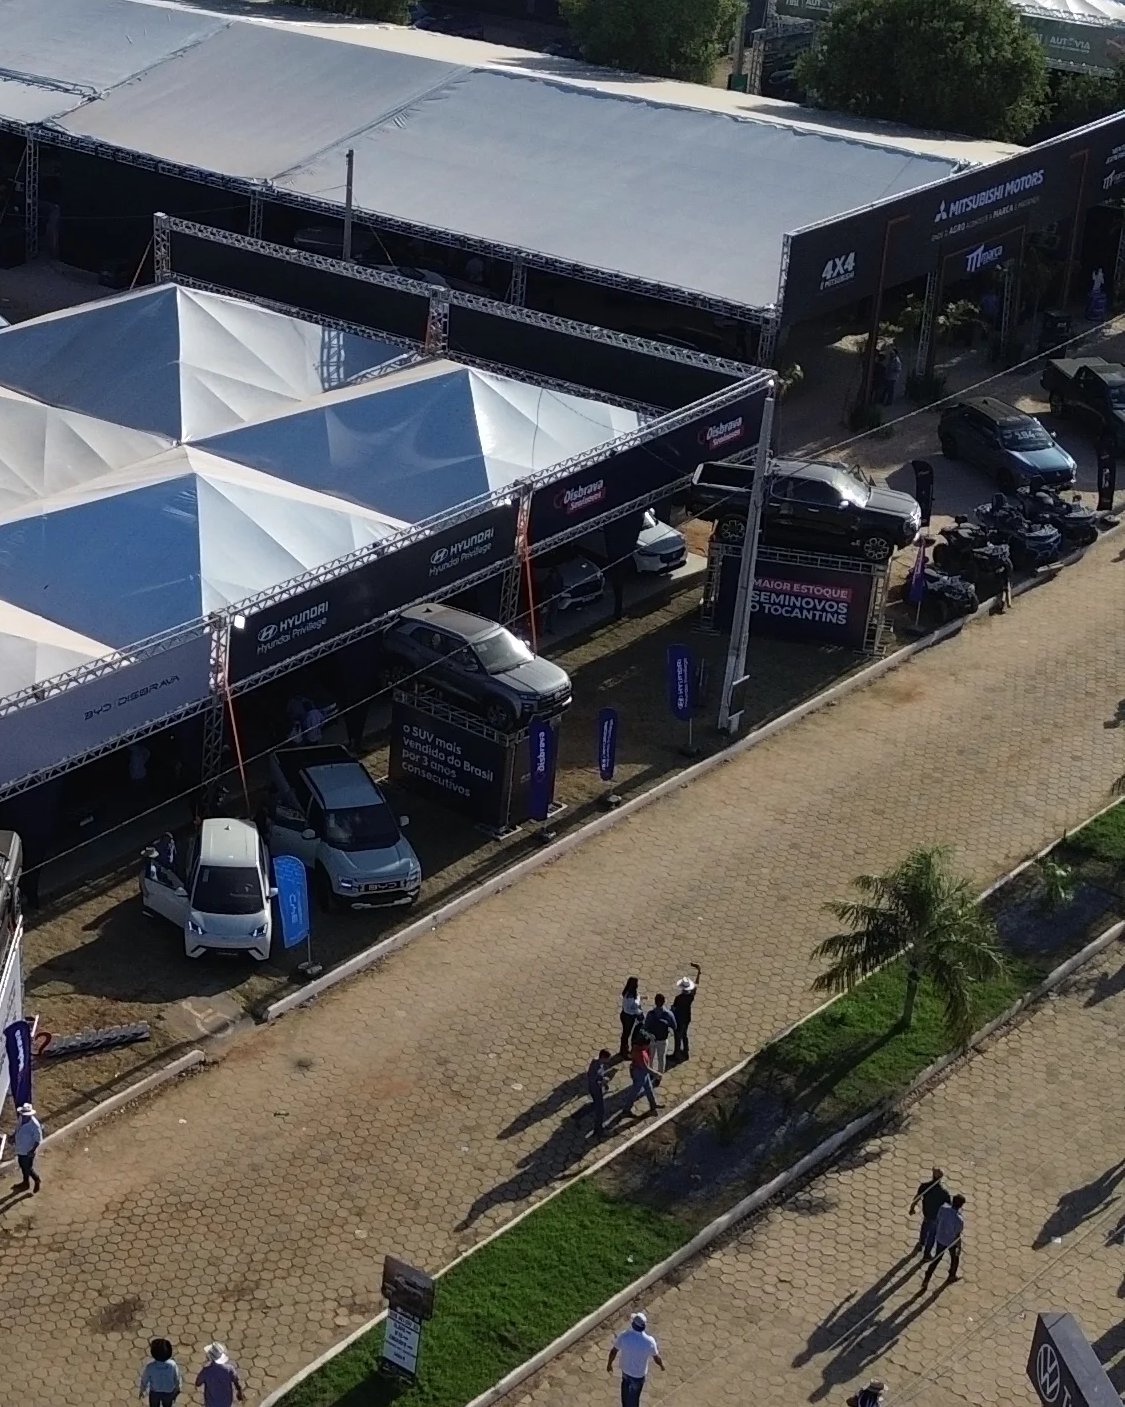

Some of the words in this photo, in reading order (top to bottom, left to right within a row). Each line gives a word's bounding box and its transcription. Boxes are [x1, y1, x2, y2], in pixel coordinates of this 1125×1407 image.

[949, 183, 1004, 218] MITSUBISHI
[1005, 169, 1045, 196] MOTORS
[949, 222, 966, 235] AGRO
[993, 204, 1014, 218] MARCA
[706, 416, 743, 440] Disbrava
[563, 479, 604, 504] Disbrava
[450, 526, 495, 556] HYUNDAI
[428, 555, 460, 577] Hyundai
[751, 591, 848, 614] SEMINOVOS
[754, 578, 791, 591] MAIOR
[793, 583, 848, 599] ESTOQUE
[279, 601, 329, 632] HYUNDAI
[763, 603, 847, 625] TOCANTINS
[256, 630, 291, 655] Hyundai
[84, 703, 112, 721] BYD
[117, 675, 180, 706] DISBRAVA
[412, 726, 434, 743] SUV
[435, 737, 462, 755] mais
[402, 748, 420, 763] por
[422, 755, 428, 766] 3
[430, 761, 457, 778] anos
[403, 737, 446, 761] vendido
[446, 754, 461, 768] do
[463, 760, 494, 782] Brasil
[401, 762, 471, 797] consecutivos
[368, 882, 397, 891] BYD
